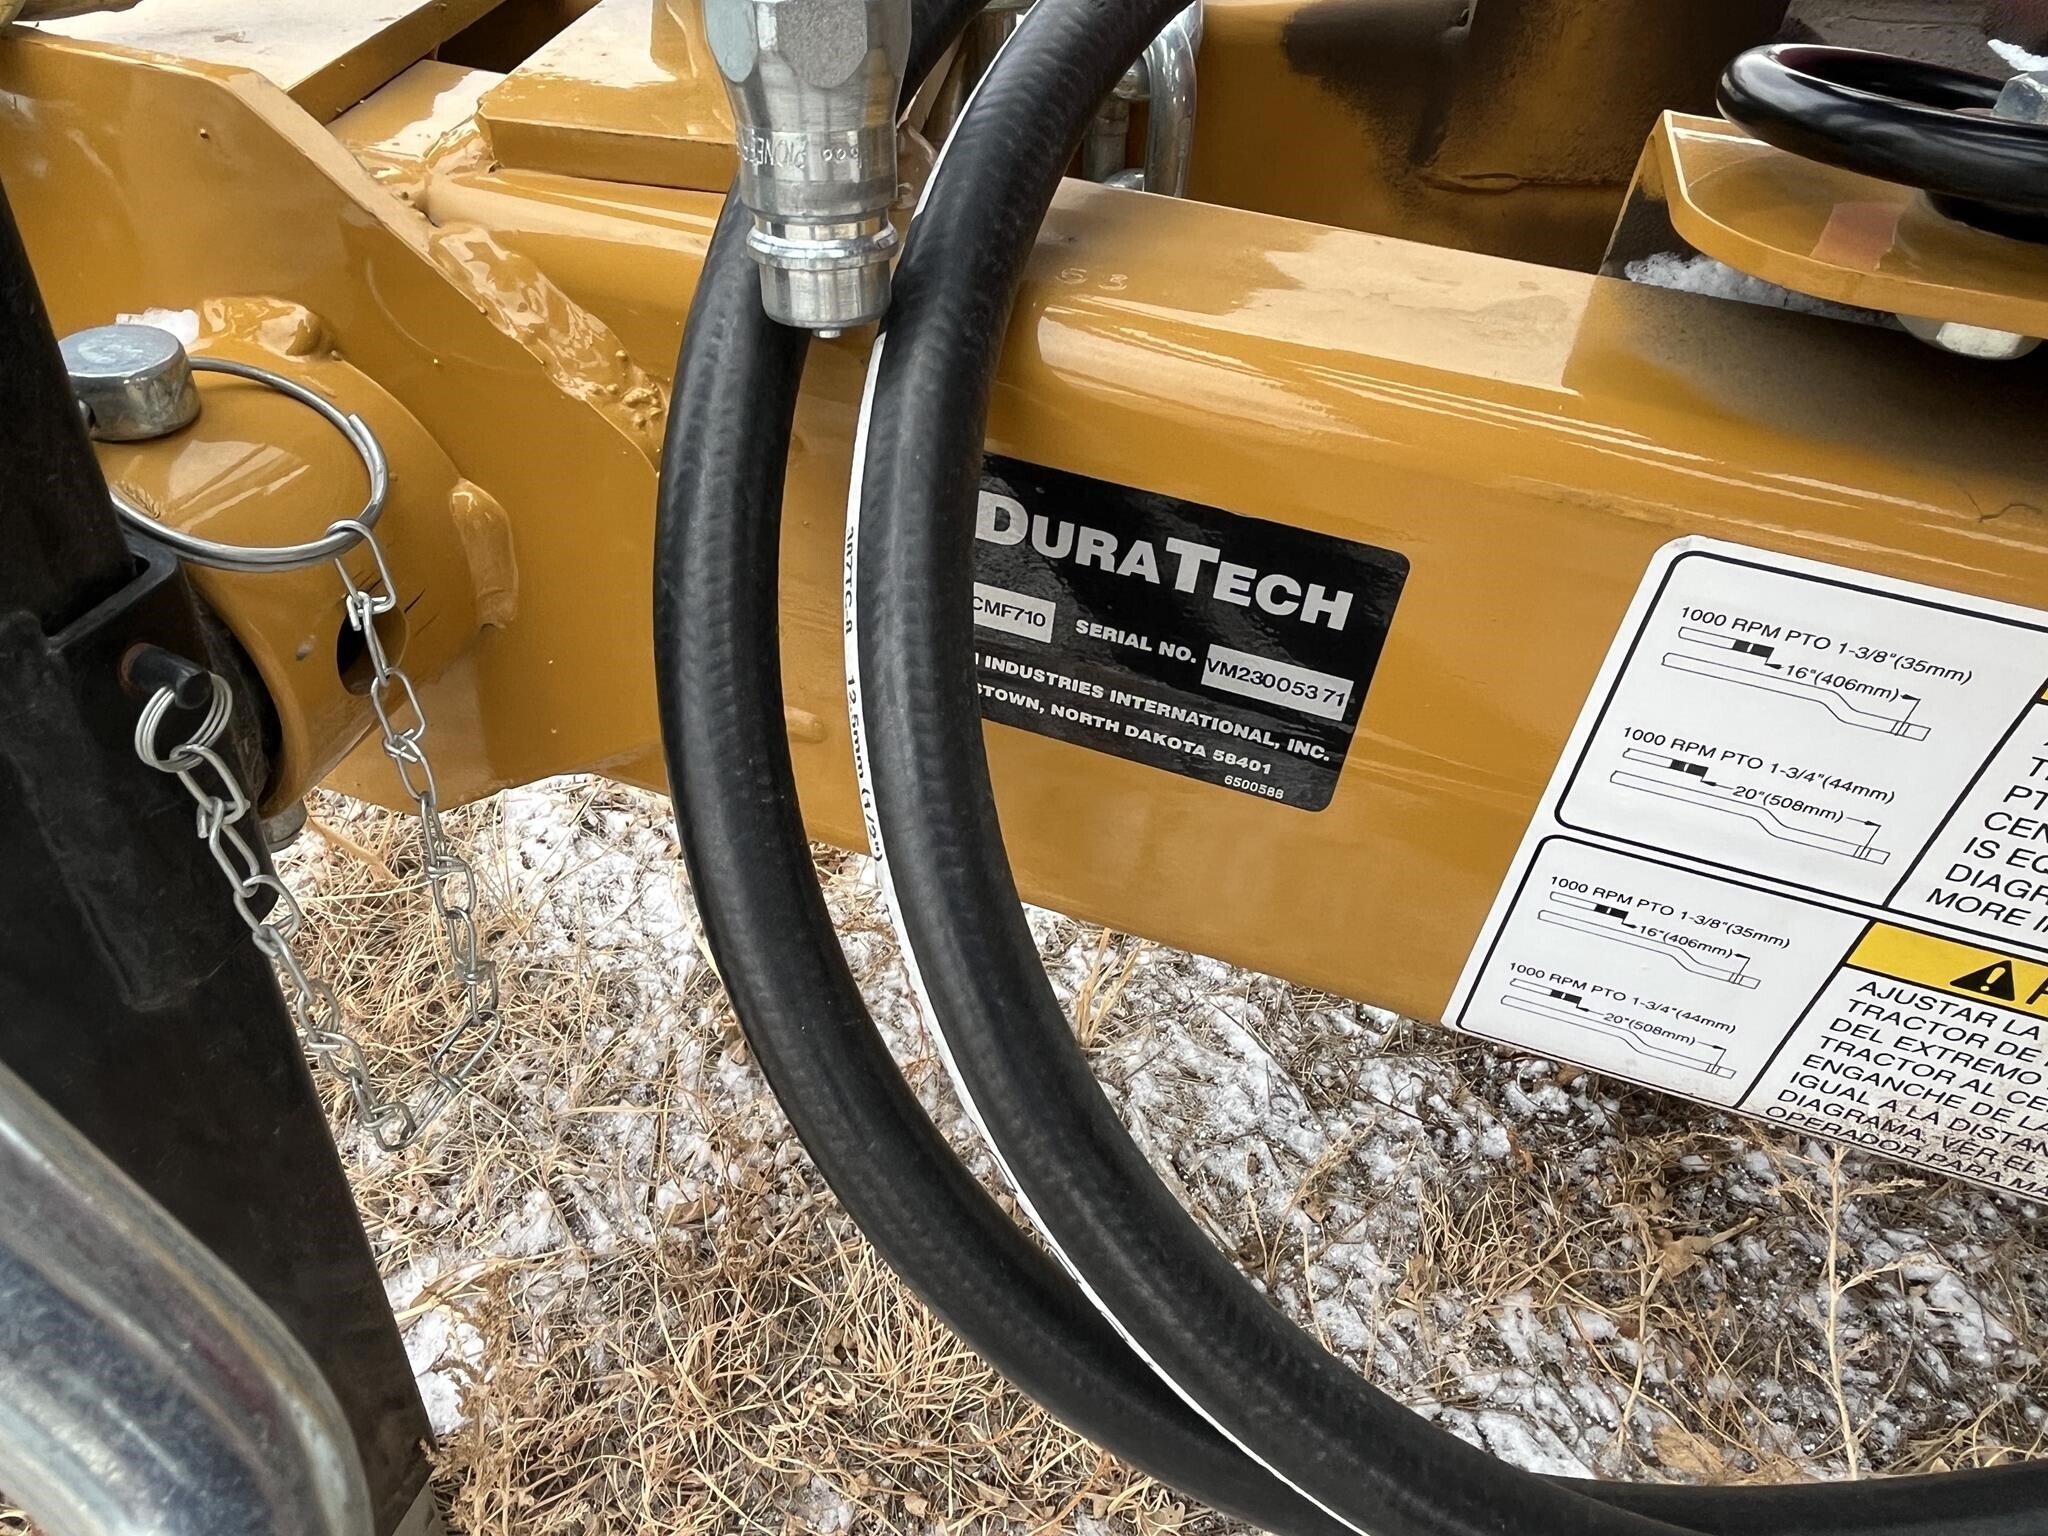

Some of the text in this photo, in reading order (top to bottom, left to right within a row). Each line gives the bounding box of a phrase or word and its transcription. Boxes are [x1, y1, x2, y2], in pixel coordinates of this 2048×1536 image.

[1075, 619, 1153, 652] SERIAL
[1157, 640, 1198, 664] NO.
[1681, 605, 1975, 686] 1000 RPM PTO 1-3/8"(35mm)
[984, 654, 1332, 762] INDUSTRIES INTERNATIONAL, INC.
[1785, 663, 1900, 703] 16"(406mm)
[1050, 703, 1121, 734] NORTH
[1125, 724, 1208, 759] DAKOTA
[1212, 750, 1273, 776] 58401
[1622, 726, 1896, 805] 1000 RPM PTO 1-3/4"(44mm)
[2028, 756, 2048, 781] T
[1732, 785, 1845, 825] 20"(508mm)
[1962, 836, 2001, 860] IS
[1549, 875, 1792, 950] 1000 RPM PTO 1-3/8"(35mm)
[1925, 887, 2032, 927] MORE
[1639, 924, 1734, 959] 16"(406mm)
[1509, 961, 1737, 1035] 1000 RPM PTO 1-3/4"(44mm)
[1602, 1011, 1697, 1047] 20"(508mm)
[1855, 980, 1999, 1030] AJUSTAR
[2002, 1018, 2041, 1042] LA
[1828, 1017, 2043, 1086] DEL EXTREMO
[1847, 998, 2043, 1065] TRACTOR DE
[1801, 1053, 1968, 1110] ENGANCHE
[1969, 1101, 2016, 1124] DE
[1819, 1036, 1958, 1086] TRACTOR
[1958, 1078, 1998, 1098] AL
[1789, 1071, 1873, 1107] IGUAL
[1876, 1098, 1900, 1114] A
[1904, 1104, 1941, 1127] LA
[1764, 1105, 1922, 1160] OPERADOR
[1925, 1152, 2003, 1183] PARA
[1940, 1135, 1999, 1165] VER
[2003, 1154, 2037, 1175] EL
